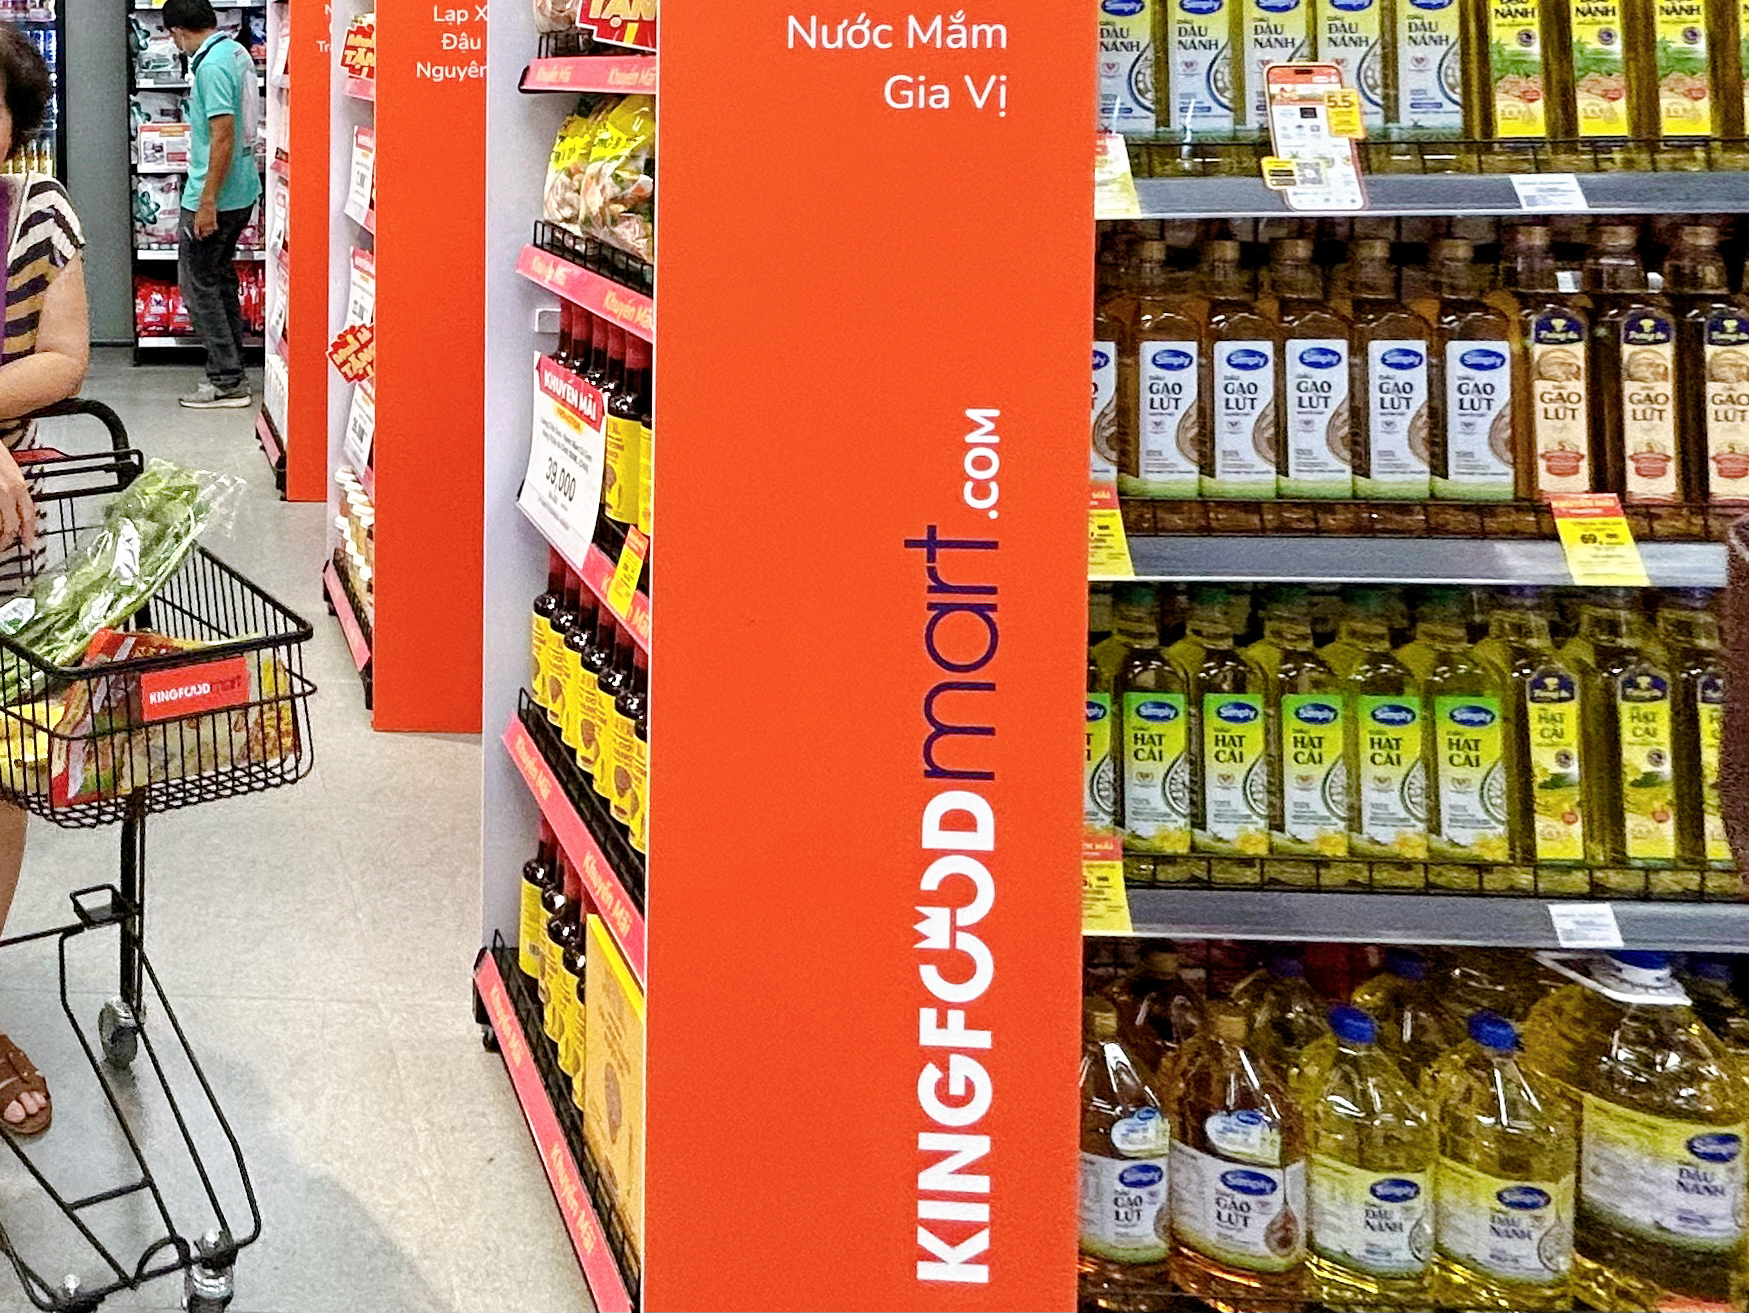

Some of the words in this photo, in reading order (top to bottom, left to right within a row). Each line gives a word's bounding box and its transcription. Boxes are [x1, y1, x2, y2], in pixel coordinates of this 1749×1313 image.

[434, 5, 469, 25] Lạp
[475, 6, 488, 21] X
[787, 11, 893, 49] Nước
[907, 8, 1008, 49] Mắm
[344, 47, 374, 70] TẶN
[441, 33, 481, 53] Đậu
[883, 74, 950, 111] Gia
[964, 74, 1008, 117] Vị
[543, 375, 578, 413] KHUYẾN
[578, 393, 597, 421] MÃI
[545, 456, 577, 503] 39,000
[582, 849, 616, 908] Khuyến
[612, 899, 631, 937] Mãi
[551, 1143, 582, 1222] Khuyến
[576, 1210, 596, 1254] Mãi
